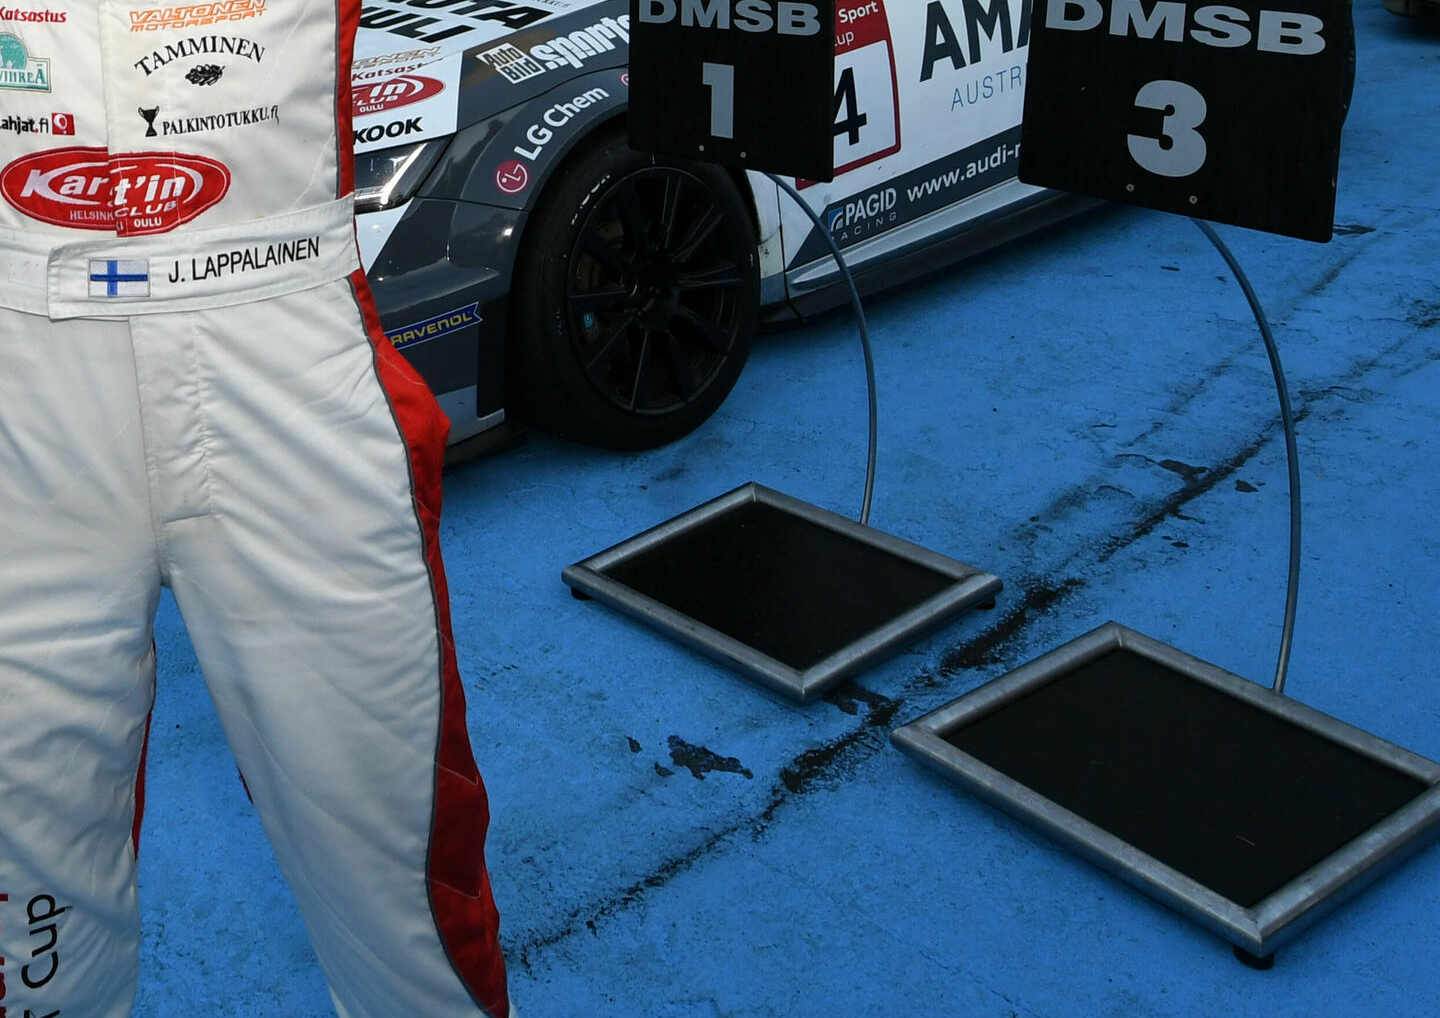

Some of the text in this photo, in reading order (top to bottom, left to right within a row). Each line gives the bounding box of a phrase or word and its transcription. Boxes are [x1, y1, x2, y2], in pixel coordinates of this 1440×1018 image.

[130, 8, 268, 32] MOTORSPORT
[838, 0, 879, 24] Sport
[834, 31, 855, 47] up
[134, 35, 266, 77] TAMMINEN
[482, 44, 523, 69] Auto
[500, 60, 540, 81] Bild
[702, 62, 735, 140] 1
[950, 63, 1027, 112] AUSTR
[359, 103, 385, 114] OULU
[513, 86, 610, 162] LG Chem
[1126, 79, 1208, 178] 3
[114, 200, 177, 218] CLUB
[133, 217, 162, 229] OULU
[845, 187, 897, 227] PAGID
[169, 236, 320, 284] J. LAPPALAINEN
[21, 894, 73, 989] Cup
